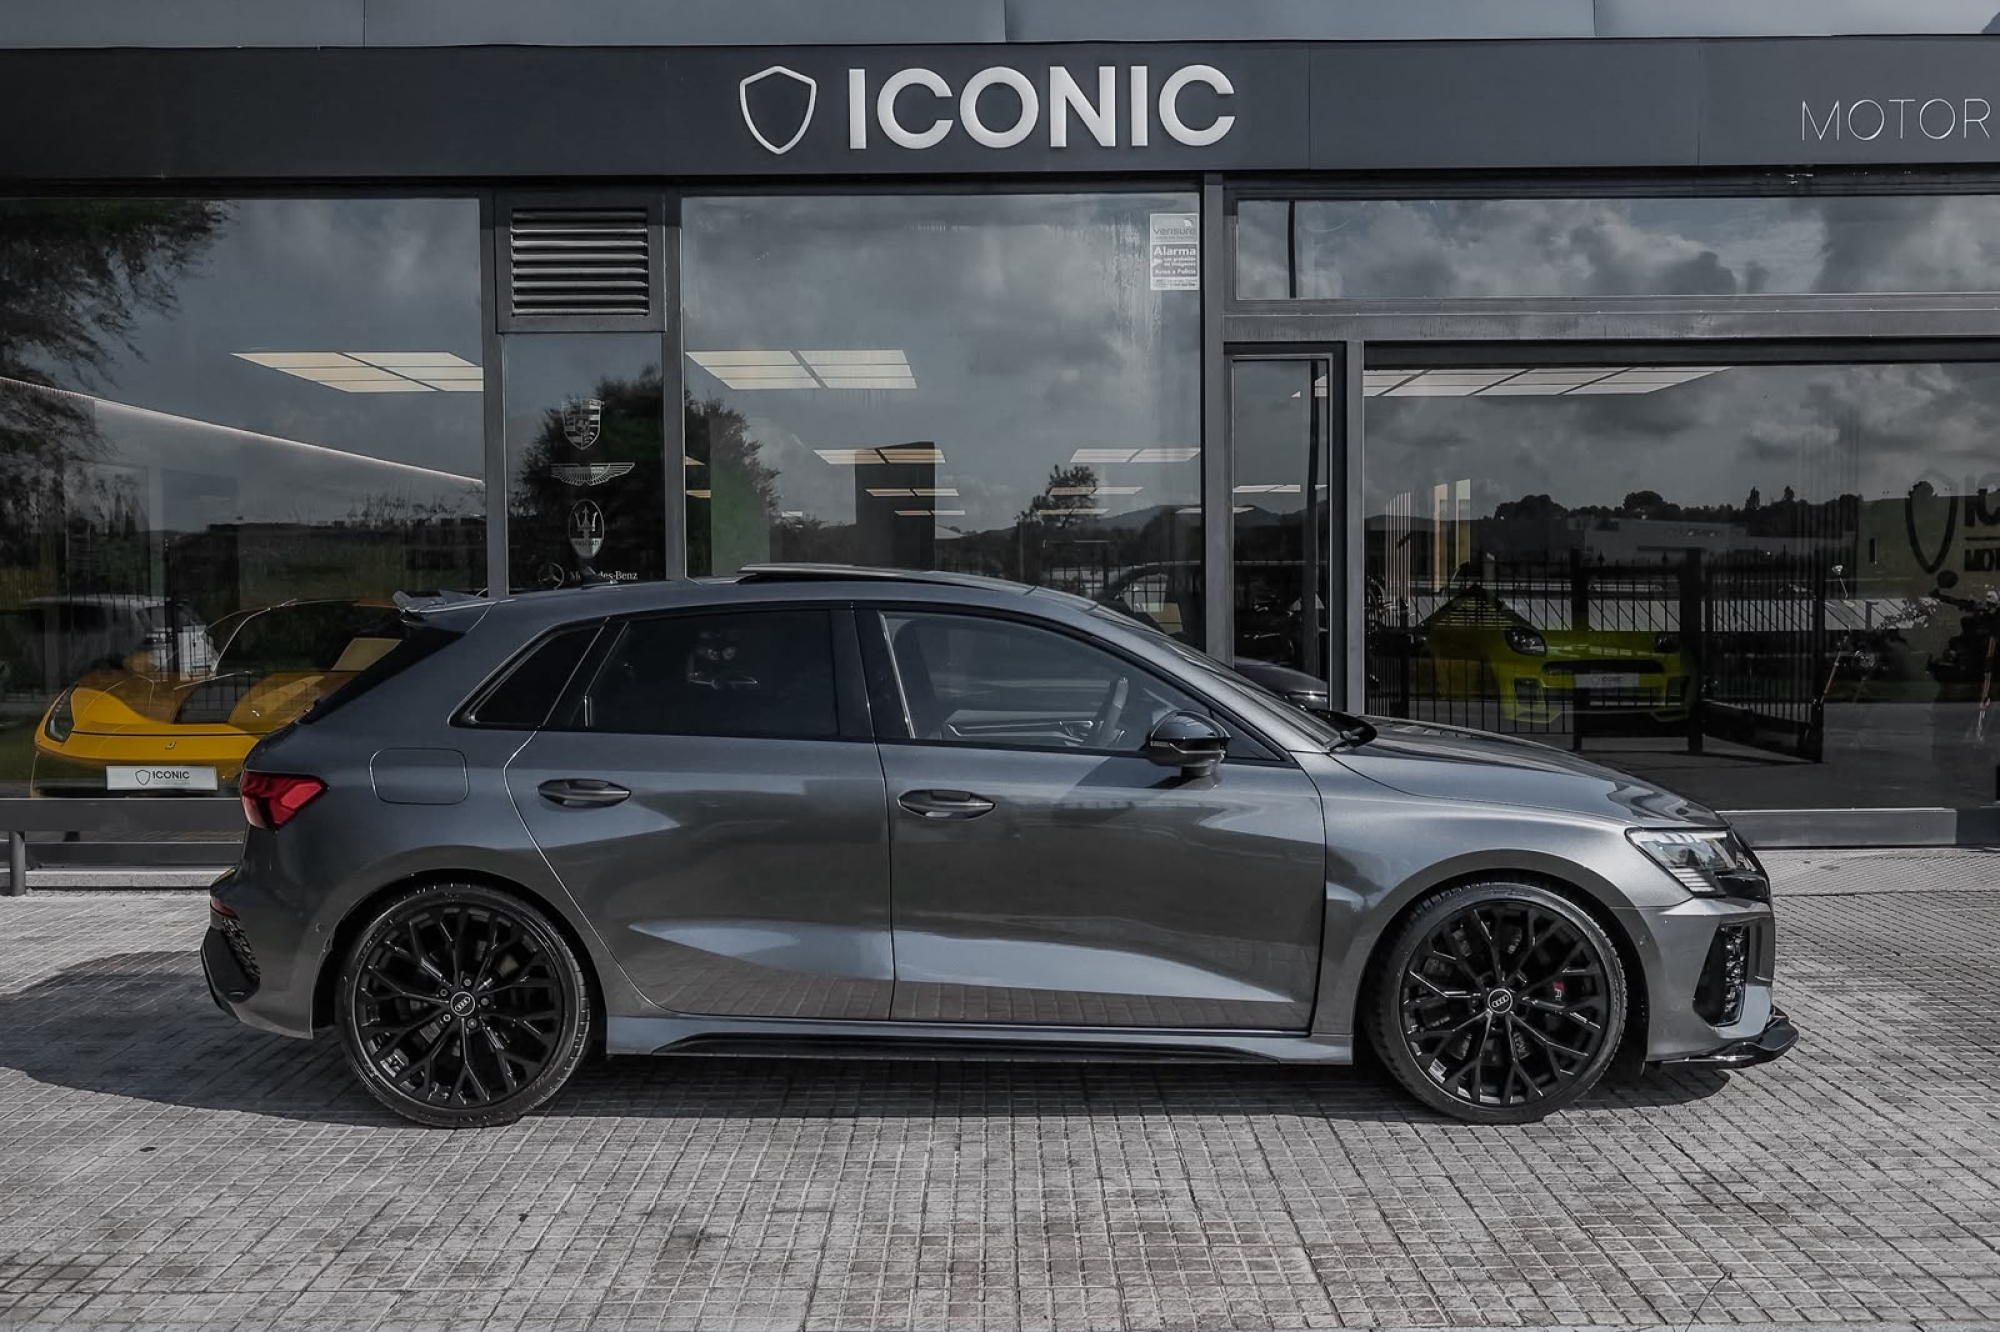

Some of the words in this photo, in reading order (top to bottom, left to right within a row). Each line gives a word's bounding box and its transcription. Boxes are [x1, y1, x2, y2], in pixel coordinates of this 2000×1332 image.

[848, 64, 1236, 150] ICONIC
[1801, 98, 1991, 141] MOTOR
[1154, 245, 1196, 256] Alarma
[152, 771, 190, 779] ICONIC
